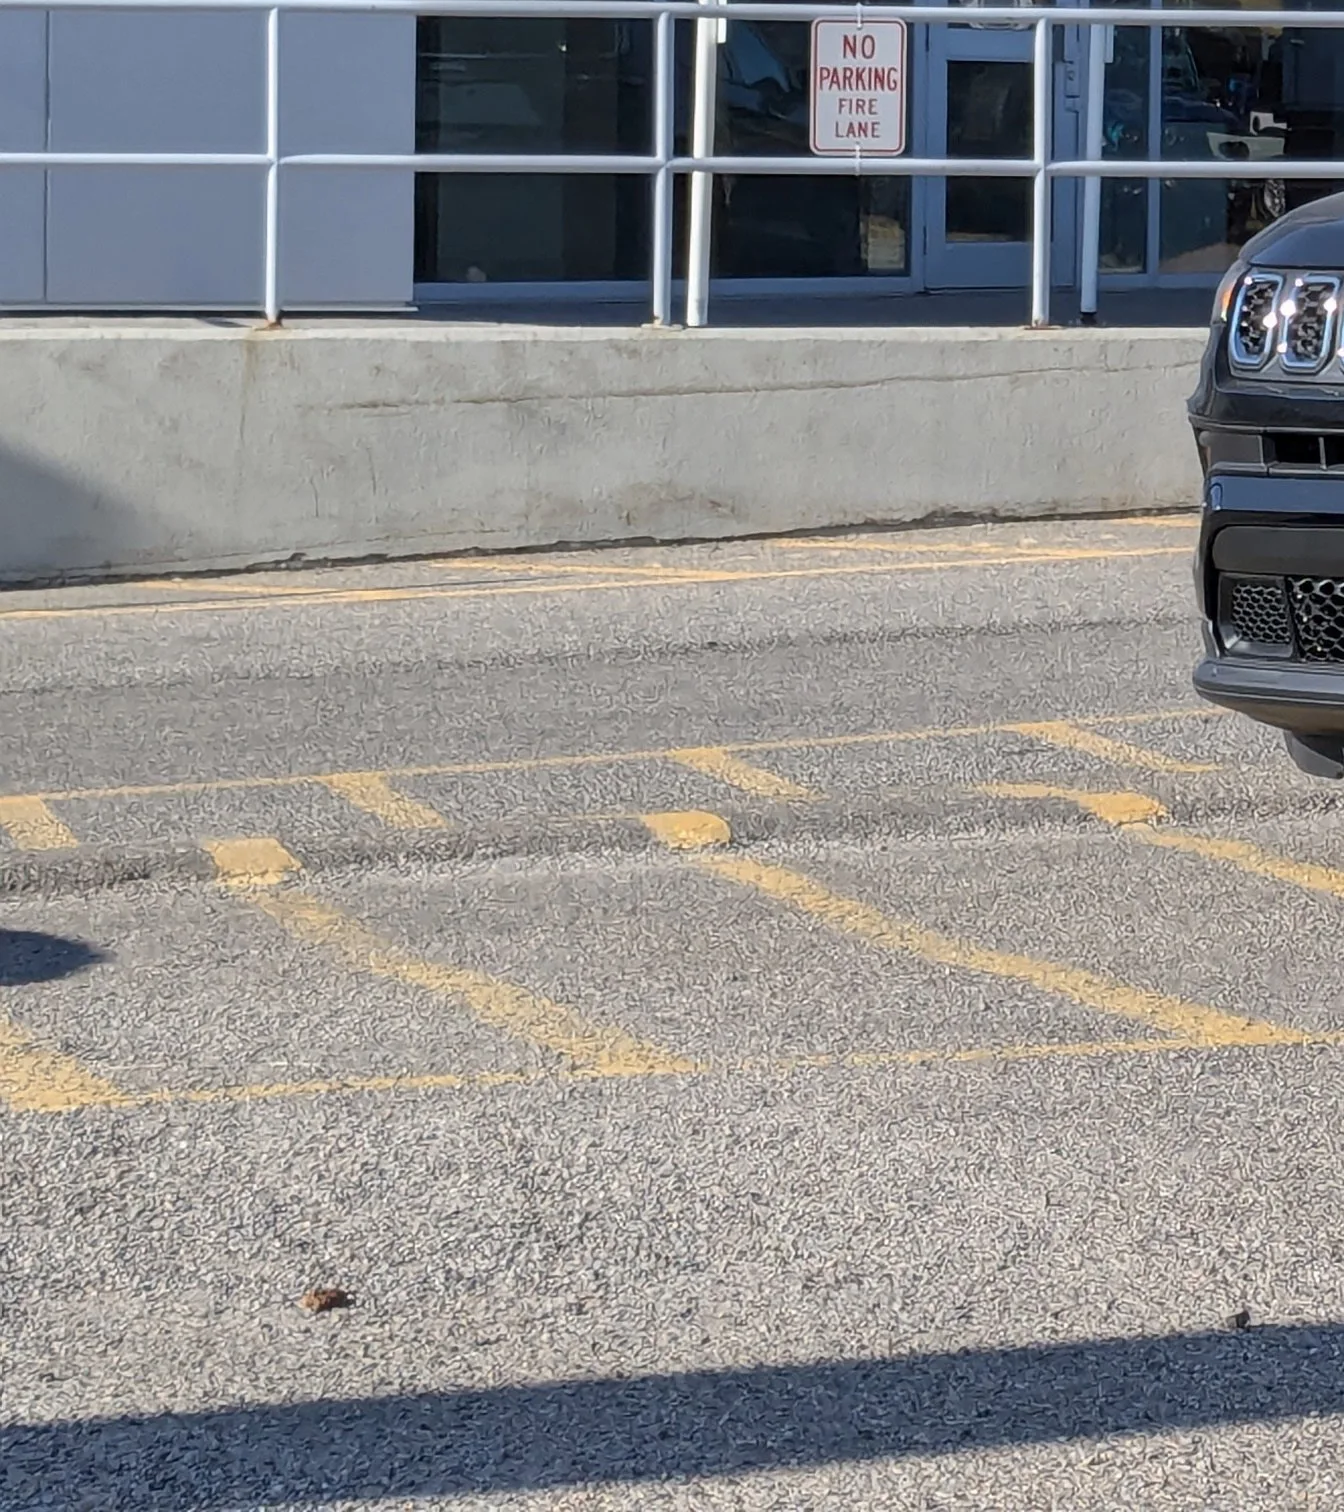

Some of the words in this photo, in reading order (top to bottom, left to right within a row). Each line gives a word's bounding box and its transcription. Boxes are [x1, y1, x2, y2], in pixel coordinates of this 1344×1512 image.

[842, 34, 876, 60] NO
[818, 66, 899, 92] PARKING
[838, 98, 879, 116] FIRE
[835, 121, 881, 139] LANE
